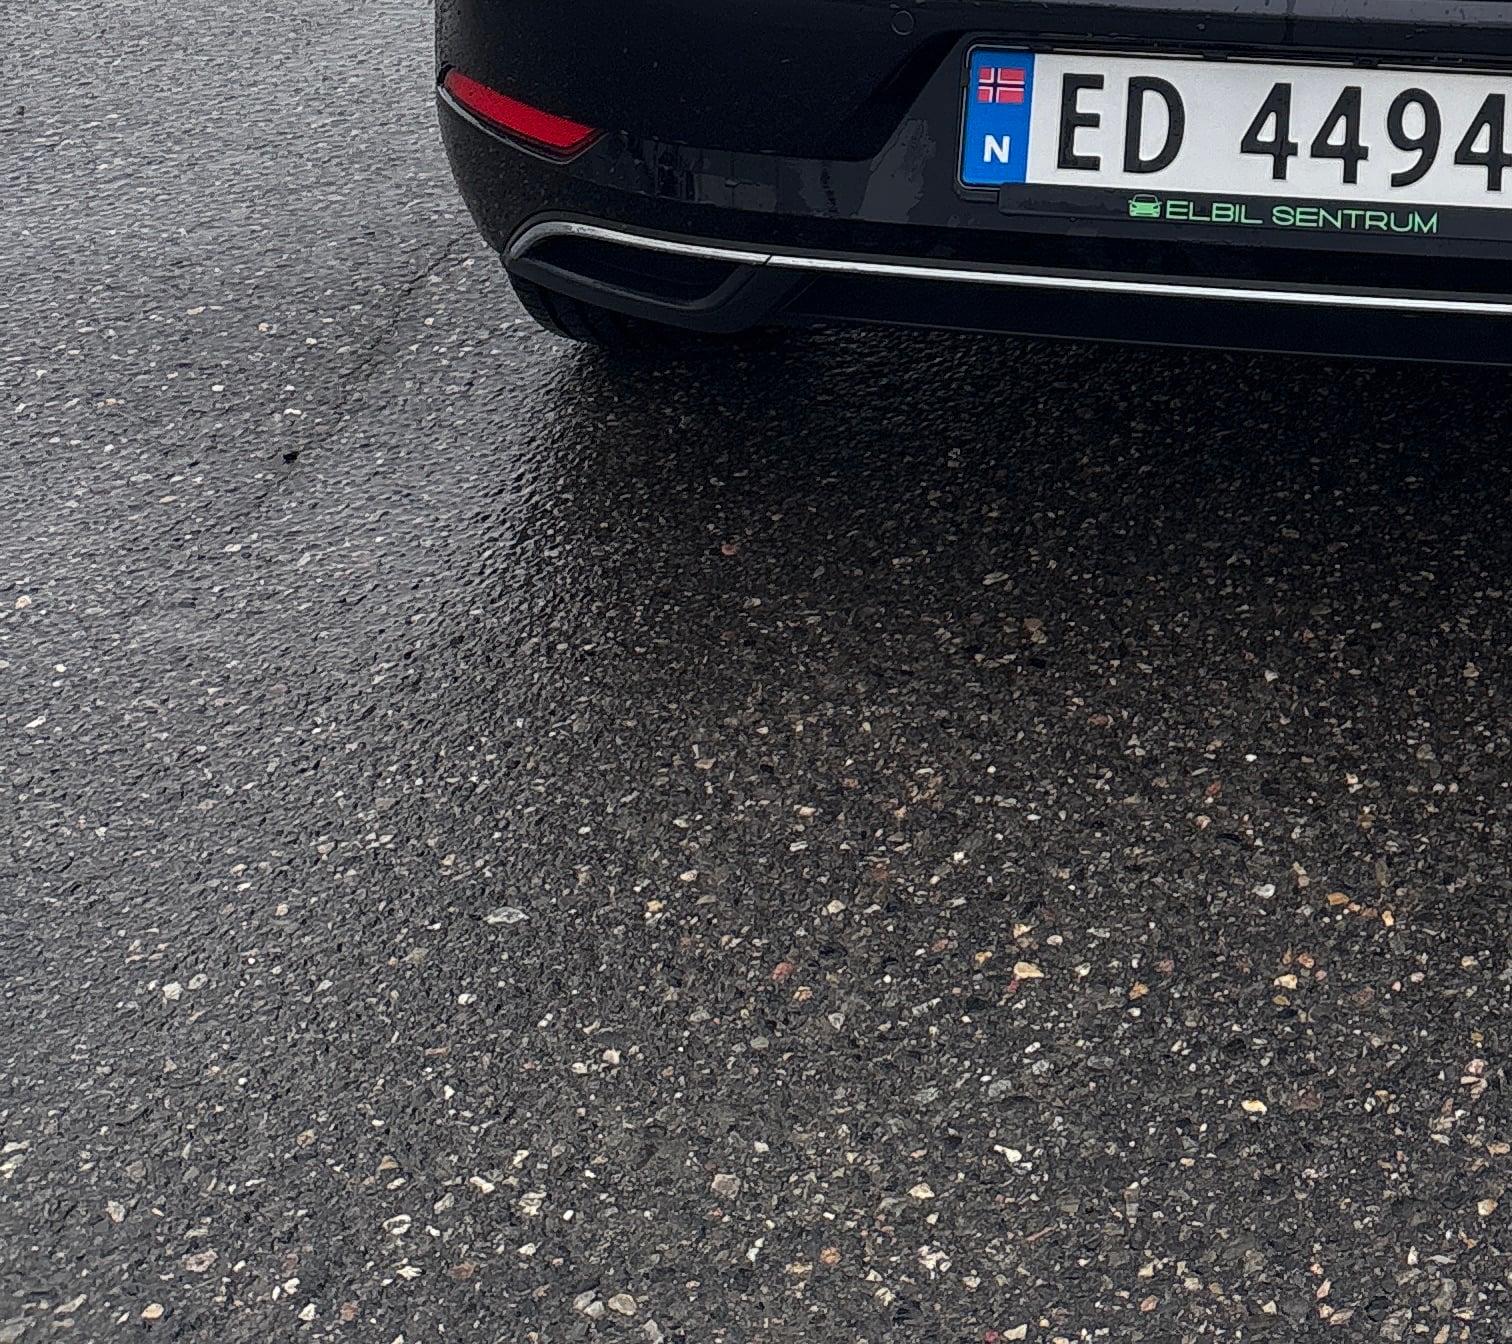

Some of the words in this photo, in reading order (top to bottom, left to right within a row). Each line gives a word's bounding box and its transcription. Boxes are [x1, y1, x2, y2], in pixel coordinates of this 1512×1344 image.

[1056, 72, 1186, 174] ED
[982, 134, 1010, 164] N
[1165, 199, 1264, 225] ELBIL
[1271, 205, 1439, 234] SENTRUM
